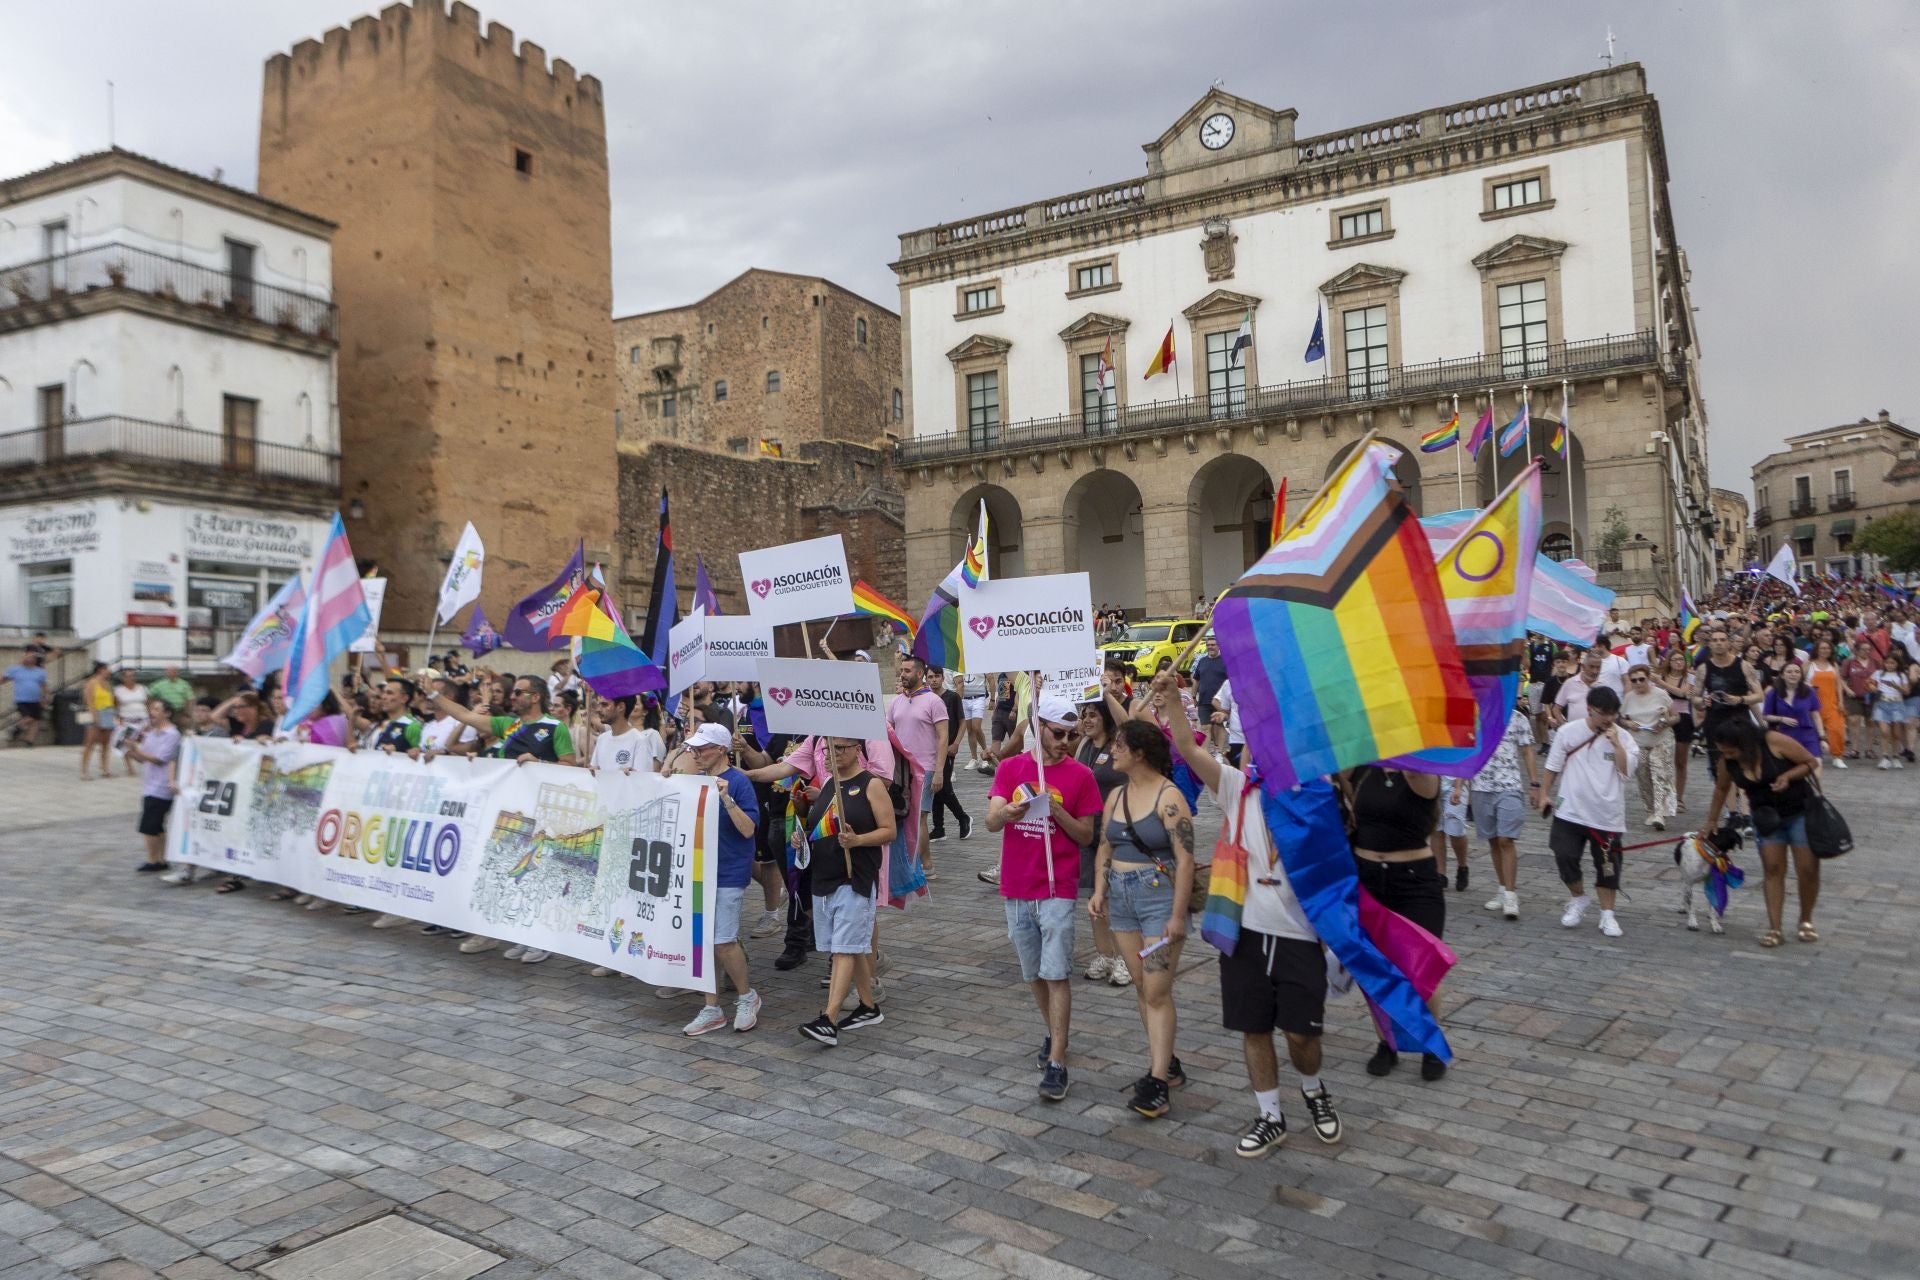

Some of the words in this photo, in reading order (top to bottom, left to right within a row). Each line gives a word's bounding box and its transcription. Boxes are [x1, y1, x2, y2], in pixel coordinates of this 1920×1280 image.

[773, 564, 842, 588] ASOCIACIÓN
[774, 577, 843, 596] CUIDADOQUETEVEO
[997, 606, 1084, 629] ASOCIACIÓN
[997, 623, 1085, 637] CUIDADOQUETEVEO
[709, 638, 768, 650] ASOCIACIÓN
[1043, 673, 1055, 683] AL
[1058, 666, 1101, 681] INFIERNO
[795, 688, 875, 704] ASOCIACIÓN
[796, 700, 876, 711] CUIDADOQUETEVEO
[199, 779, 236, 816] 29
[439, 800, 467, 818] CON
[316, 808, 462, 877] ORGULLO
[628, 837, 672, 897] 29
[671, 833, 687, 930] JUNIO
[636, 900, 655, 922] 2025
